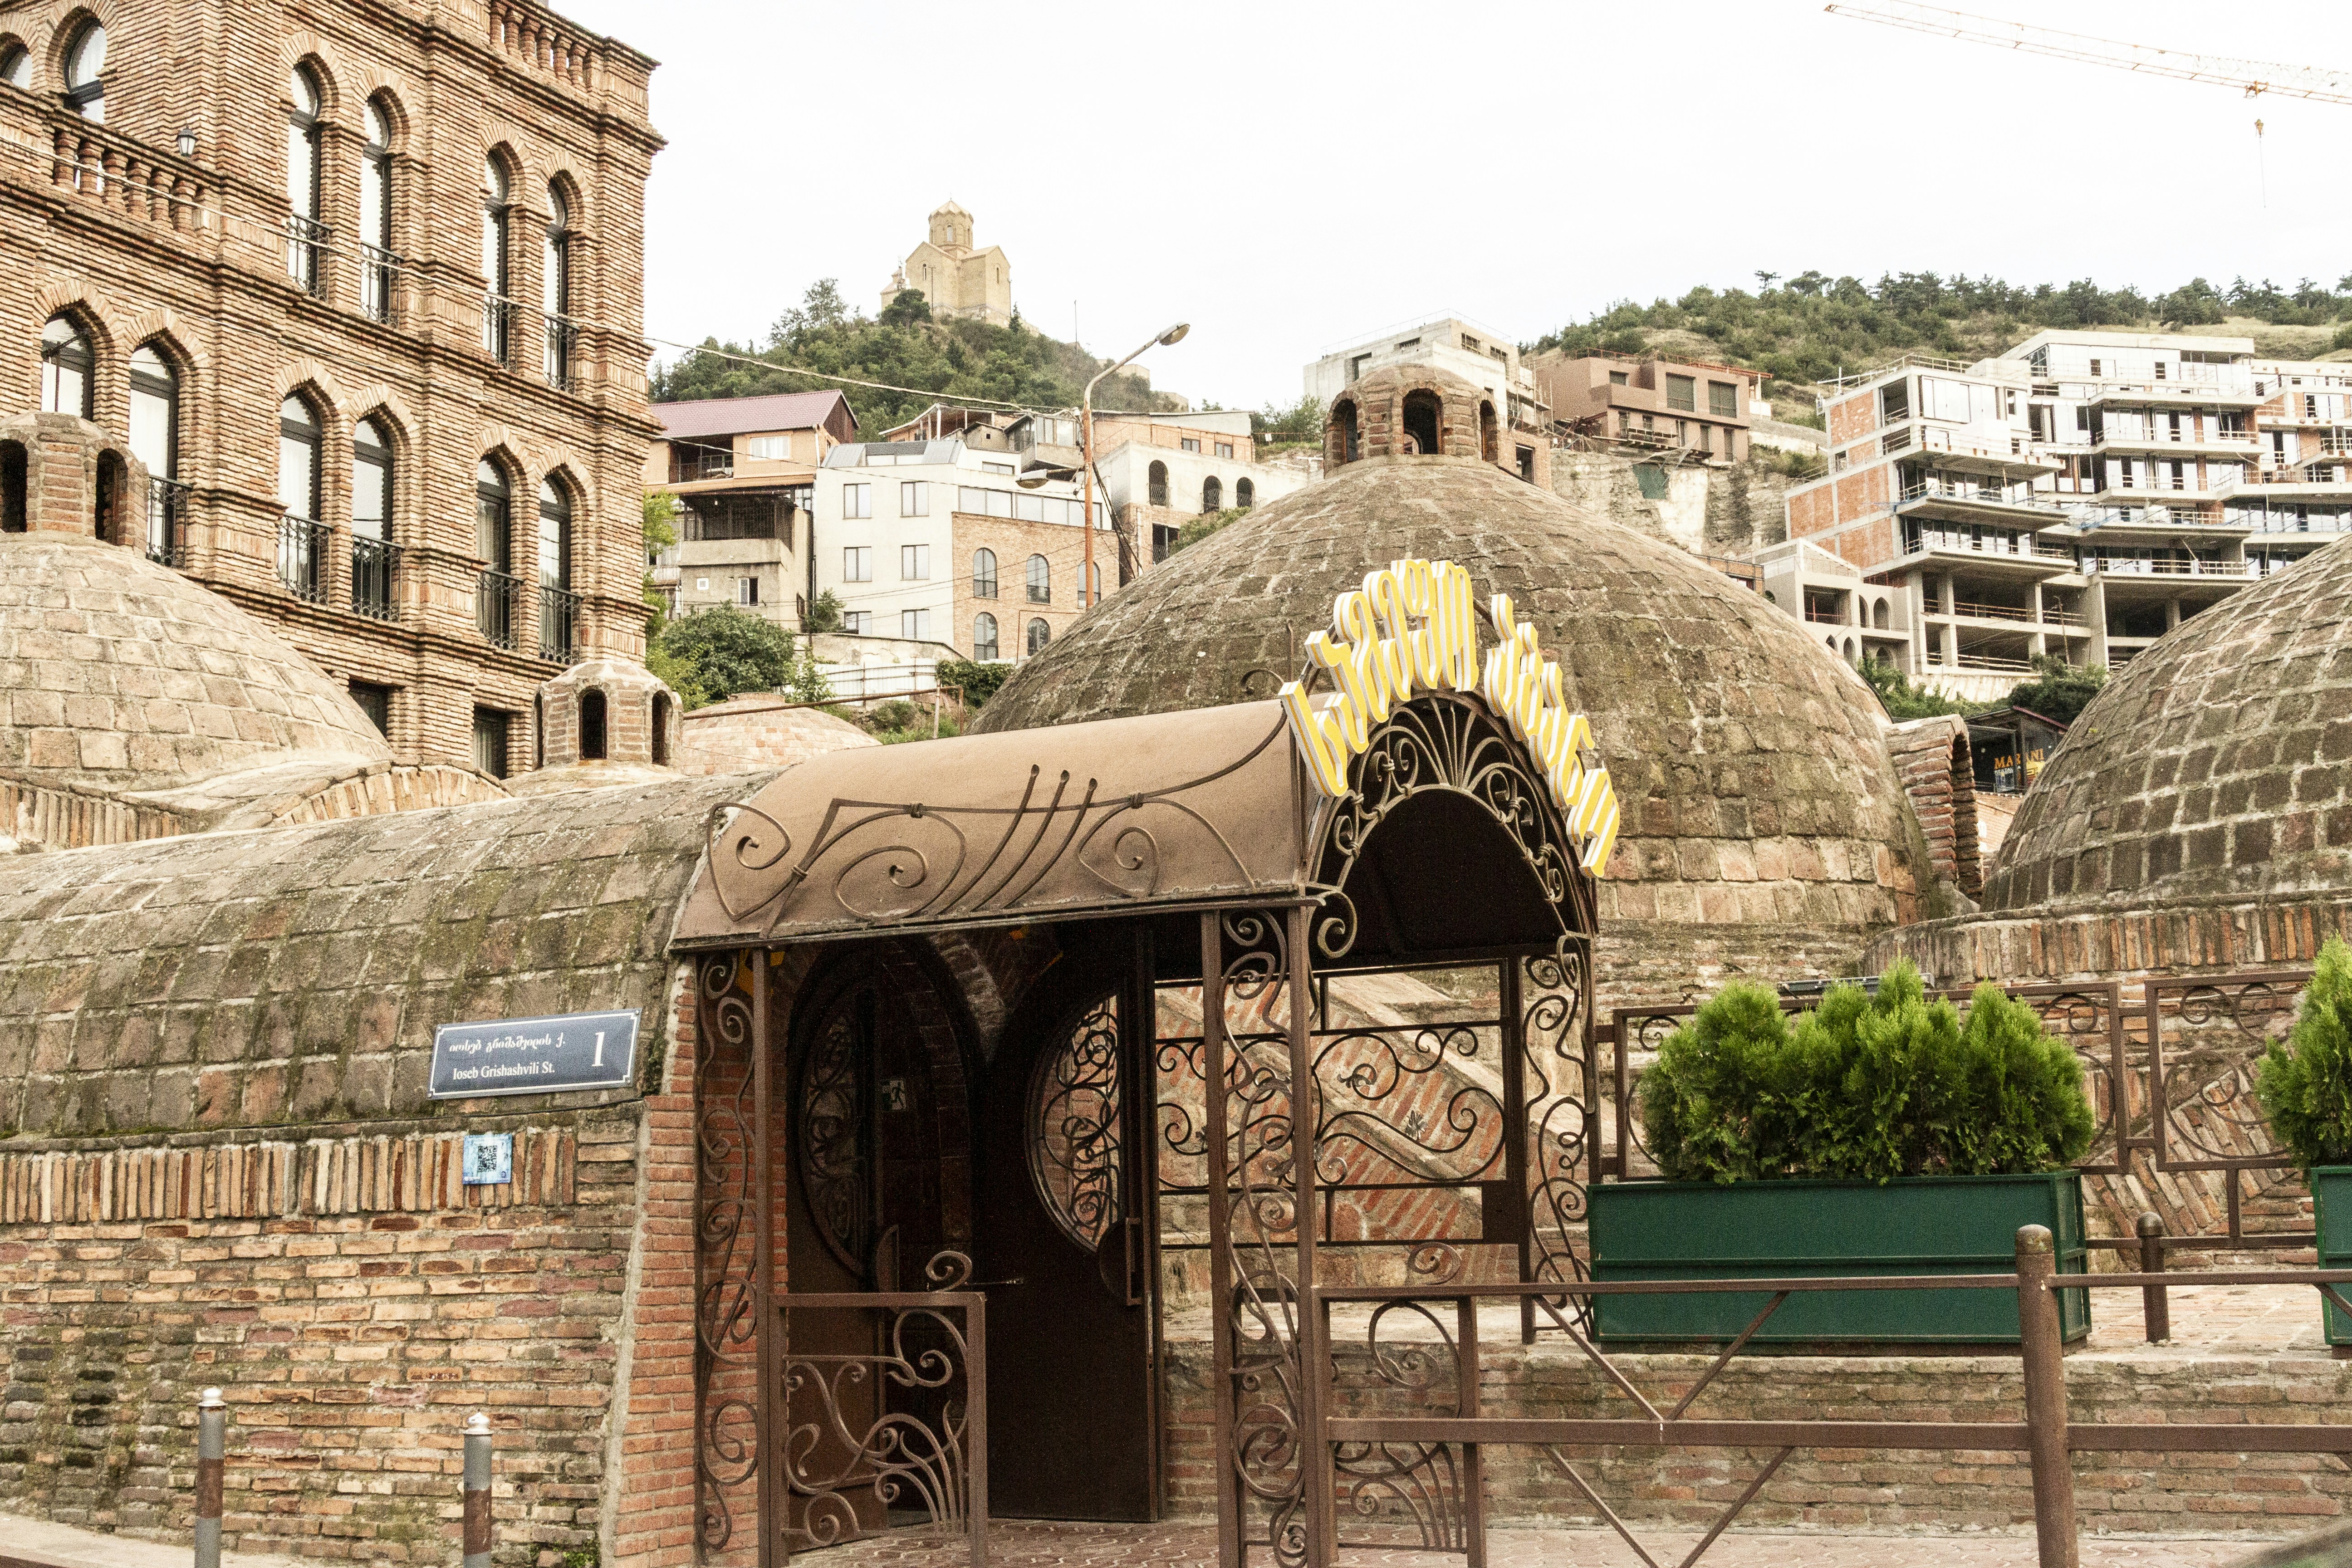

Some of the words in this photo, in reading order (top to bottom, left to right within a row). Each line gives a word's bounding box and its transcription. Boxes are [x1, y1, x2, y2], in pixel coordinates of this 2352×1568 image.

[449, 1039, 482, 1054] იოსებ
[485, 1034, 551, 1053] გრიშაშვილის
[555, 1032, 566, 1048] ქ.
[592, 1031, 605, 1067] 1
[453, 1067, 479, 1080] Ioseb
[481, 1061, 539, 1078] Grishashvili
[542, 1061, 556, 1074] St.
